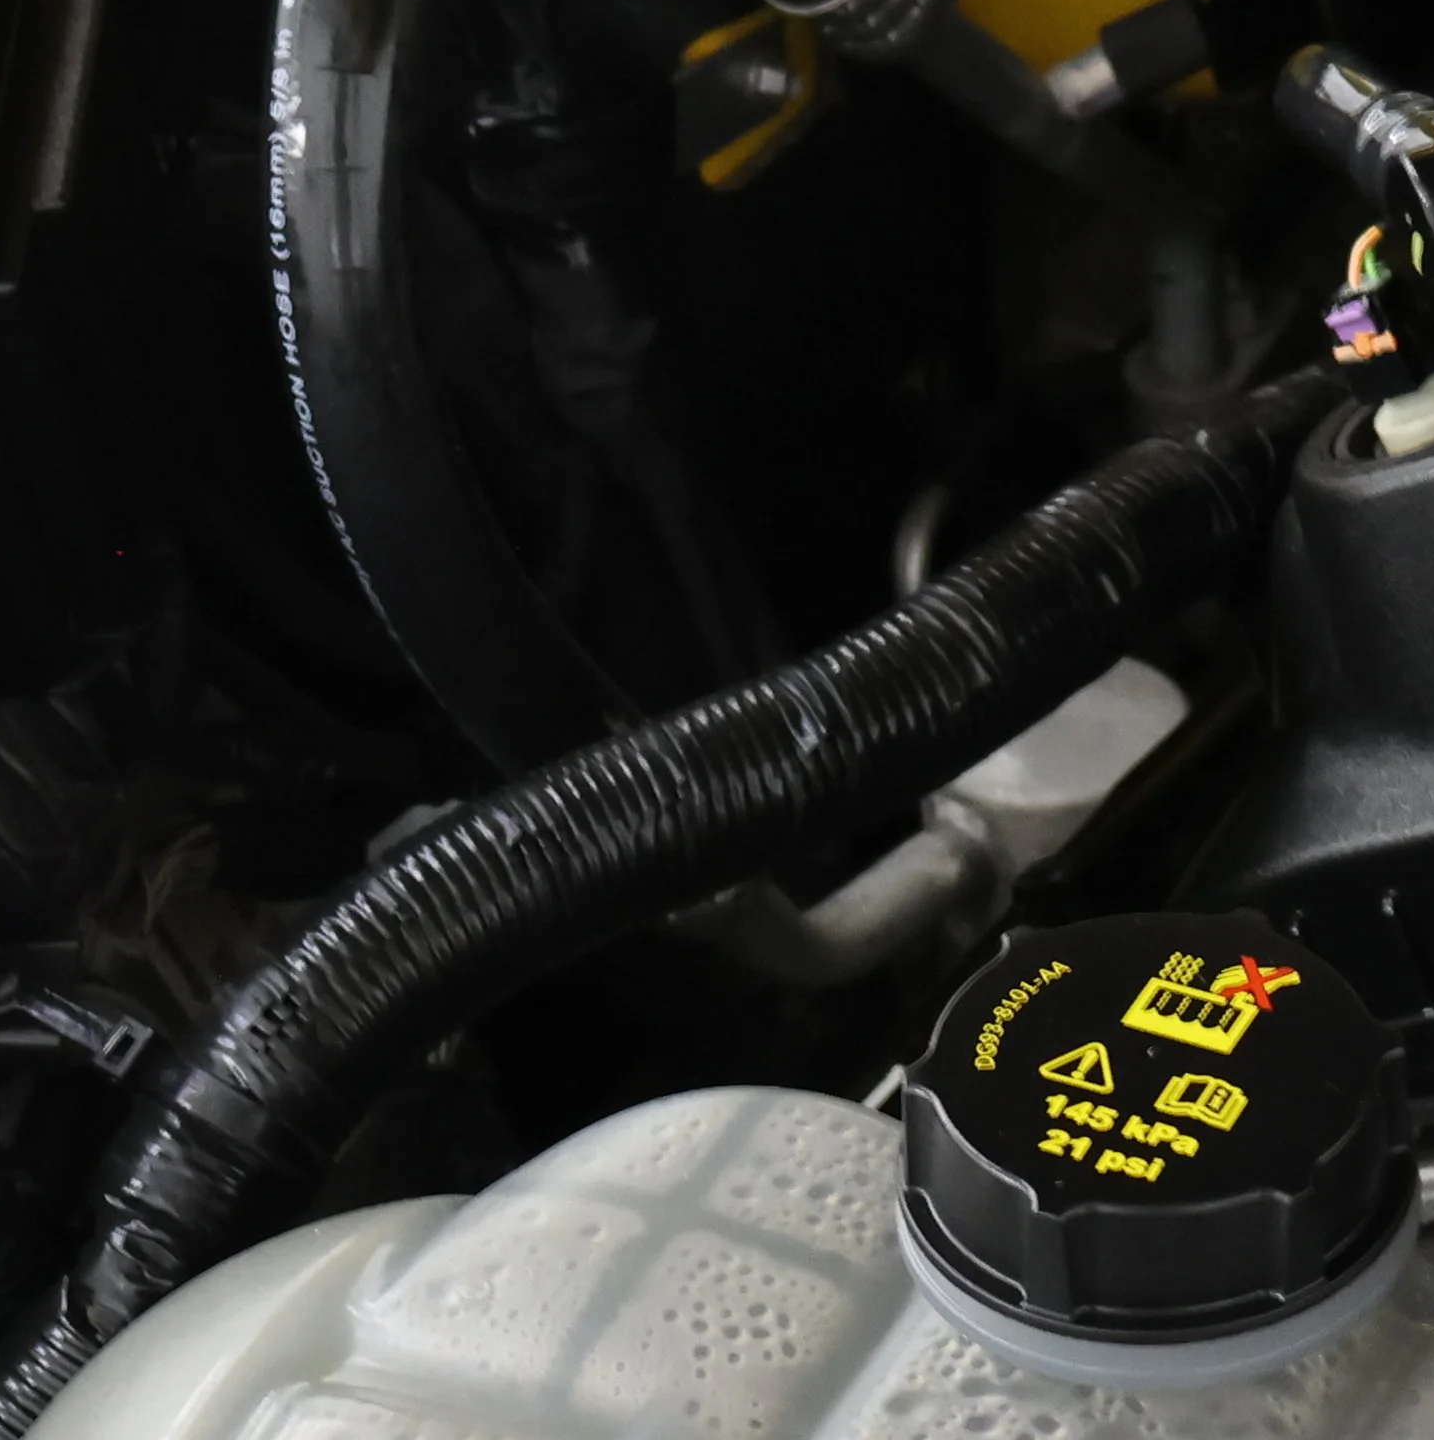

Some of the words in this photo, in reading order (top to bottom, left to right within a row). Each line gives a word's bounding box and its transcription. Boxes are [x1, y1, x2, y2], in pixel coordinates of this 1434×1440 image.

[272, 268, 301, 367] HOSE
[288, 373, 337, 507] SUCTION
[974, 960, 1073, 1071] DG93-8101-AA
[1037, 1128, 1093, 1162] 21
[1094, 1148, 1166, 1183] psi
[1045, 1093, 1120, 1133] 145
[1121, 1114, 1201, 1158] kPa
